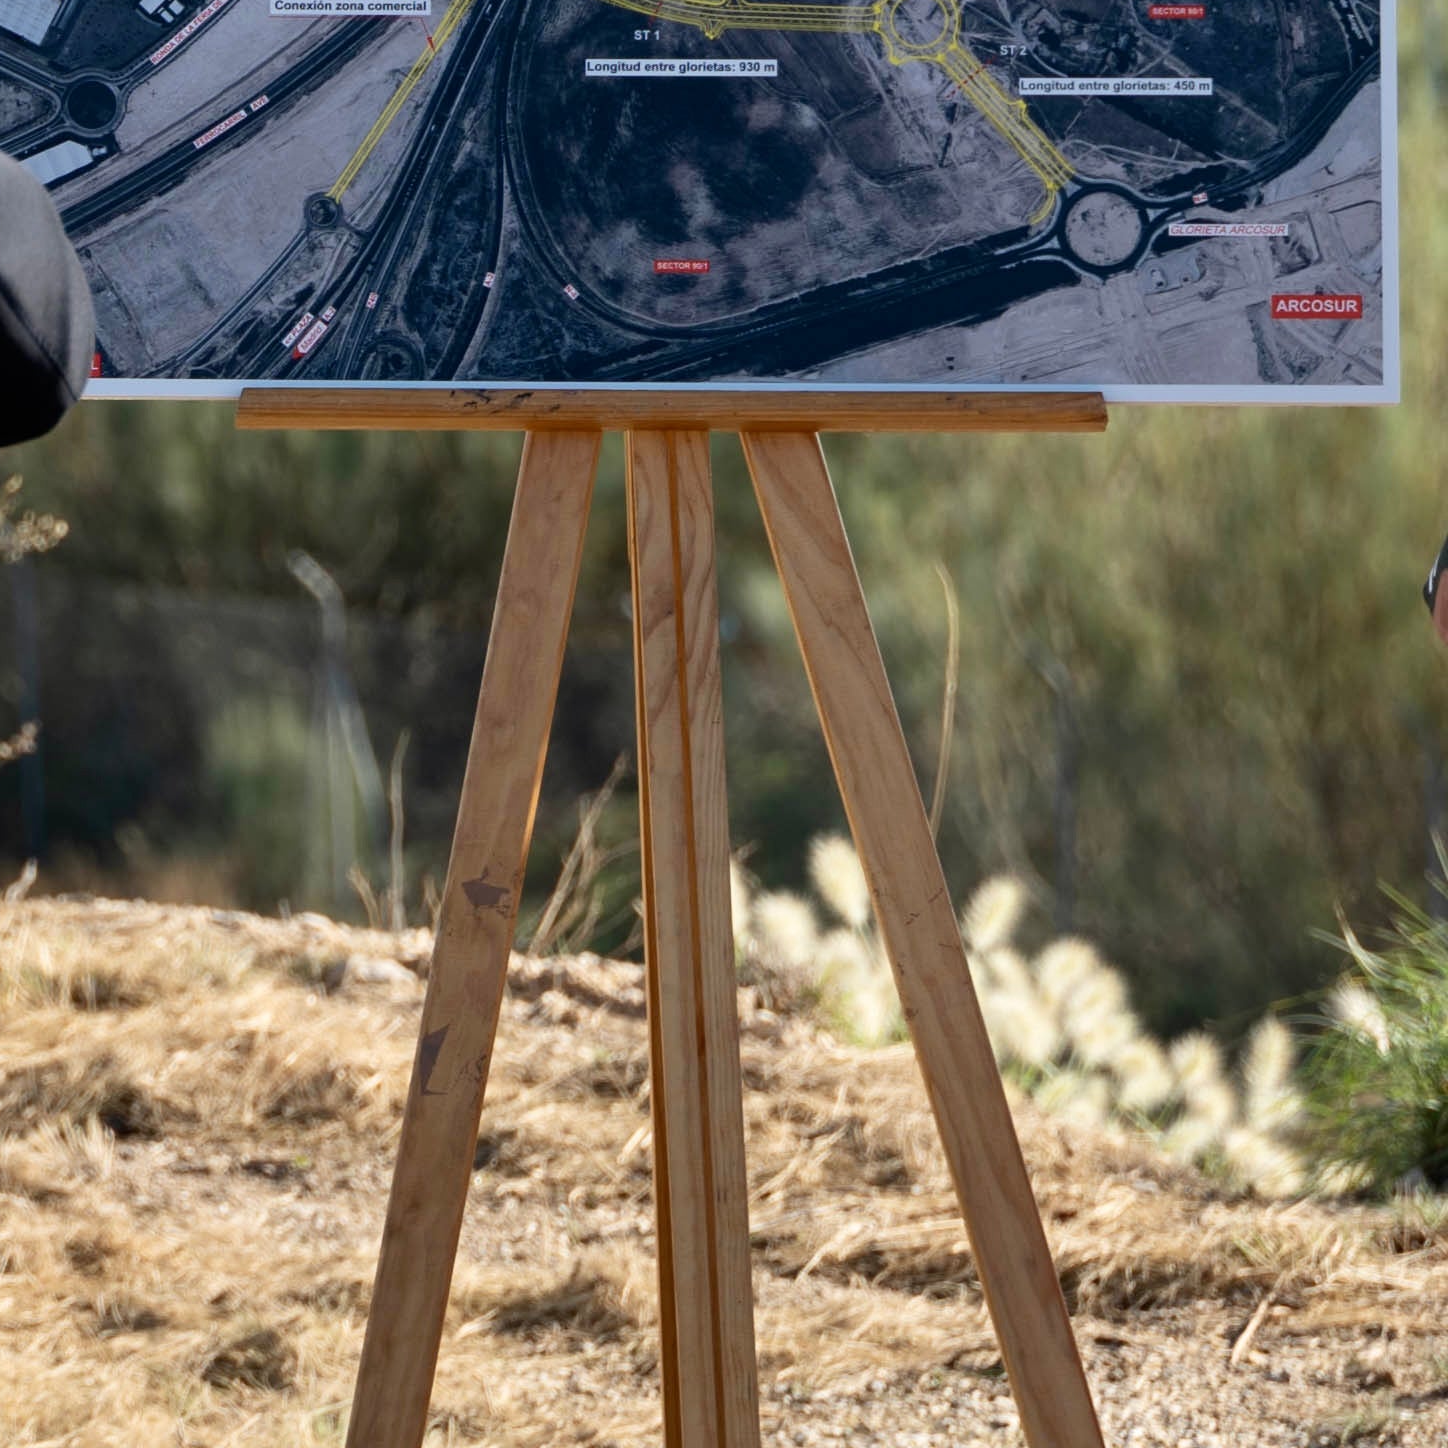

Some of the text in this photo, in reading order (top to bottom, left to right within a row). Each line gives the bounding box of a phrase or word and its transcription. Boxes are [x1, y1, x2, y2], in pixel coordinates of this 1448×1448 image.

[275, 0, 427, 12] Conexión zona comercial
[633, 30, 661, 41] ST 1
[1000, 45, 1027, 56] ST 2
[587, 61, 776, 74] Longitud entre glorietas: 930 m
[1020, 80, 1210, 93] Longitud entre glorietas: 450 m
[1170, 225, 1286, 235] GLORIETA ARCOSUR
[656, 261, 690, 269] SECTOR
[1275, 299, 1358, 313] ARCOSUR
